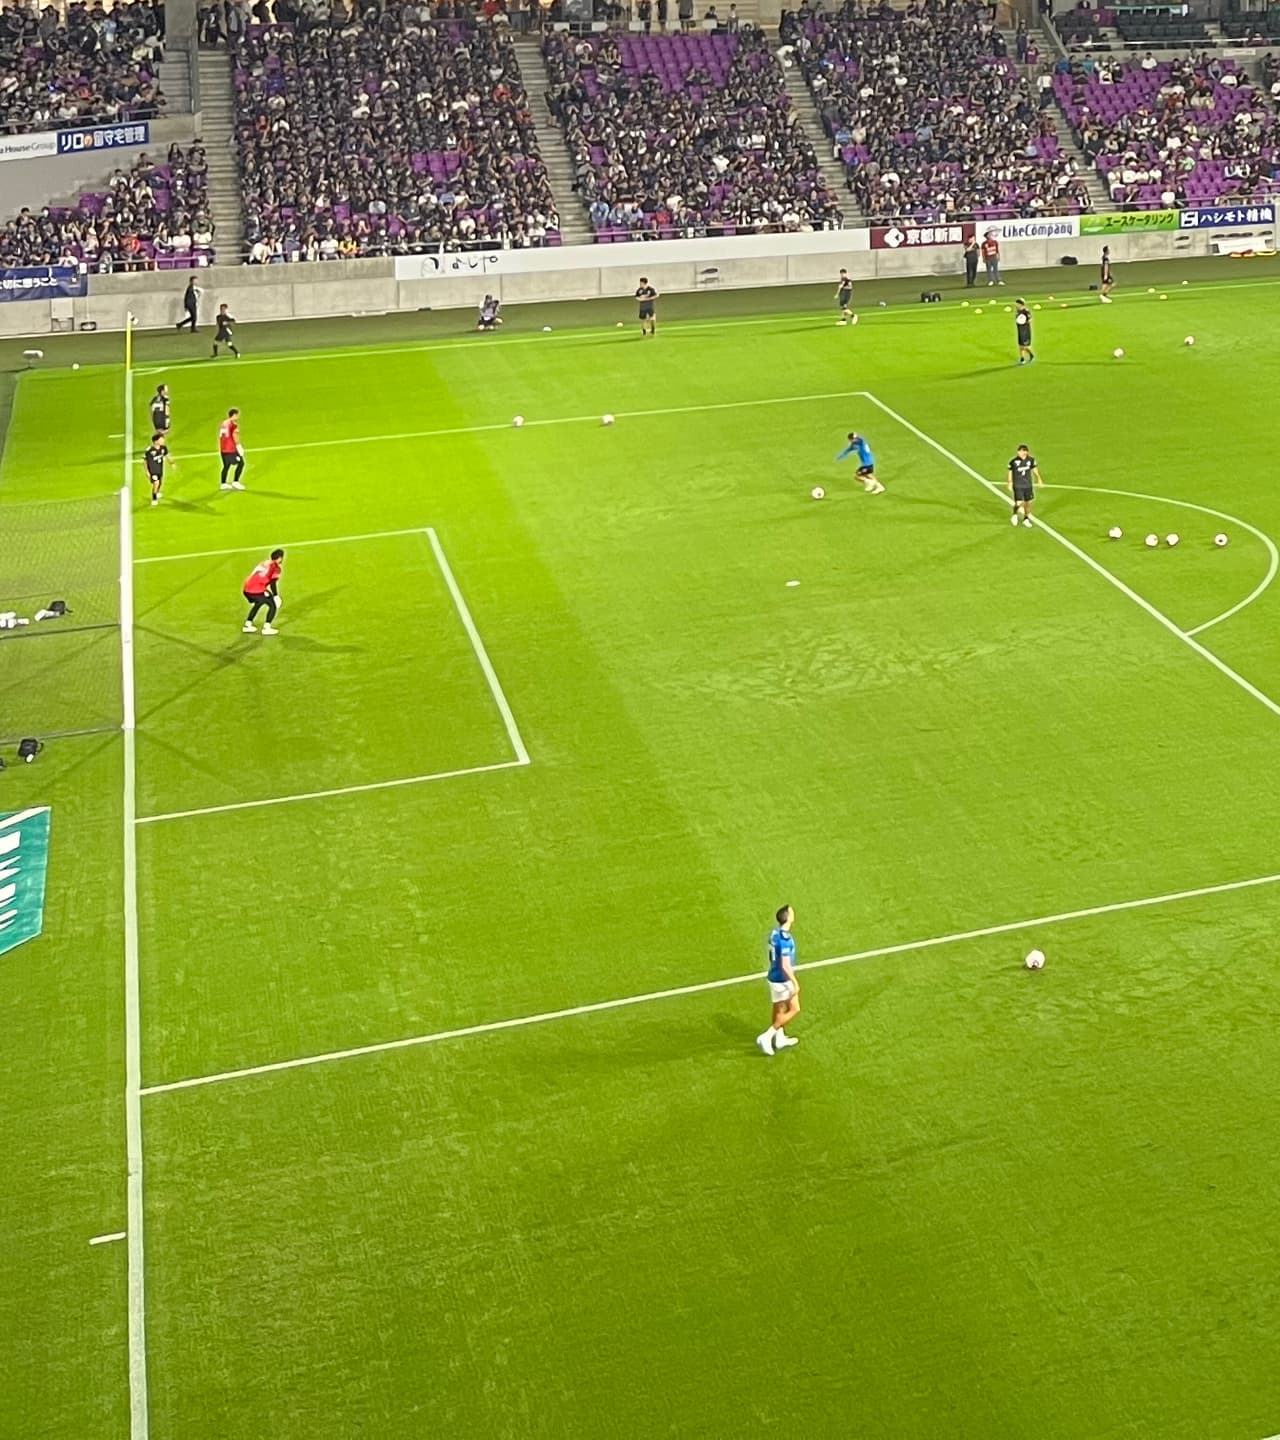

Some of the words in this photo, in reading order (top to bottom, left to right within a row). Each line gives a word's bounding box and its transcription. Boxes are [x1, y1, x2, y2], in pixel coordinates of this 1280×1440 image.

[61, 126, 146, 151] リロの留守宅管理
[1105, 213, 1174, 227] エースケータリング
[1201, 208, 1273, 224] ハシモト精機
[906, 226, 964, 245] 京都新聞
[1002, 222, 1073, 238] LikeCompany
[0, 276, 58, 291] 切に思うこと
